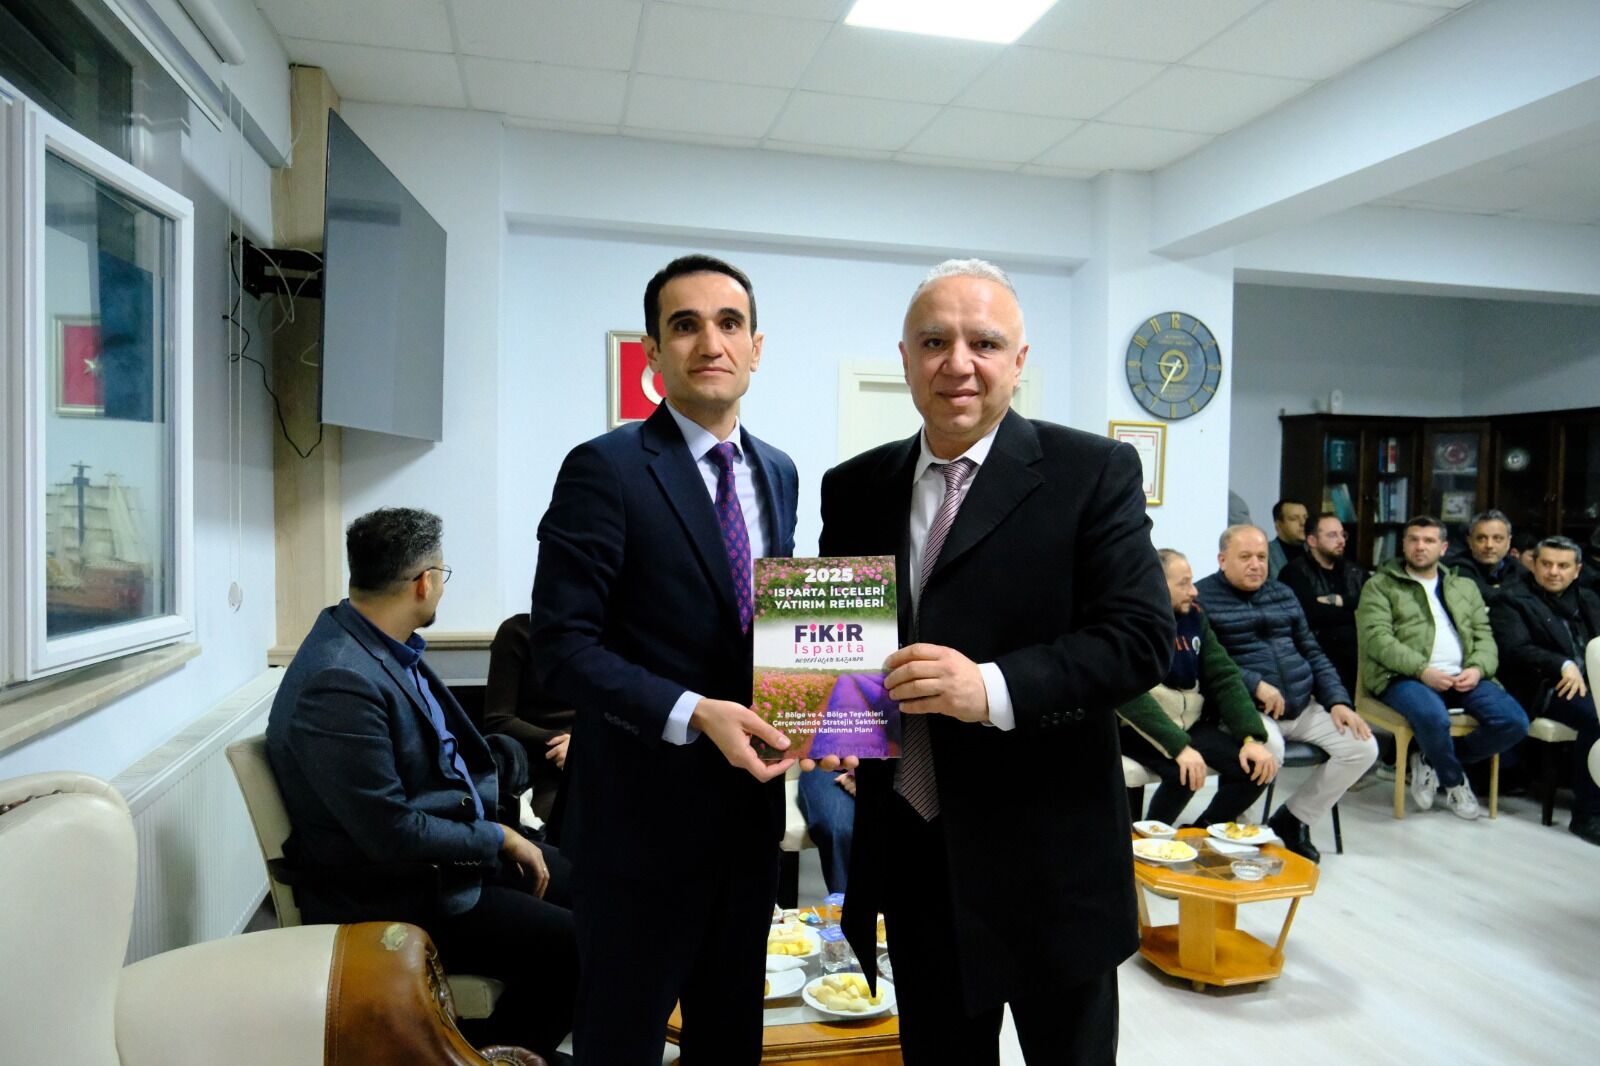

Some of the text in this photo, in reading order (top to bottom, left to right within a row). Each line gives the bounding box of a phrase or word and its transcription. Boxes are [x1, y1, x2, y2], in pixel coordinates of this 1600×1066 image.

[804, 567, 854, 583] 2025
[774, 584, 885, 598] ISPARTA İLÇELERİ
[774, 598, 884, 610] YATIRIM REHBERİ
[794, 642, 865, 656] Isparta
[784, 711, 806, 719] Bölge
[826, 711, 848, 719] Bölge
[849, 710, 884, 718] Teşvikleri
[822, 719, 853, 727] Stratejik
